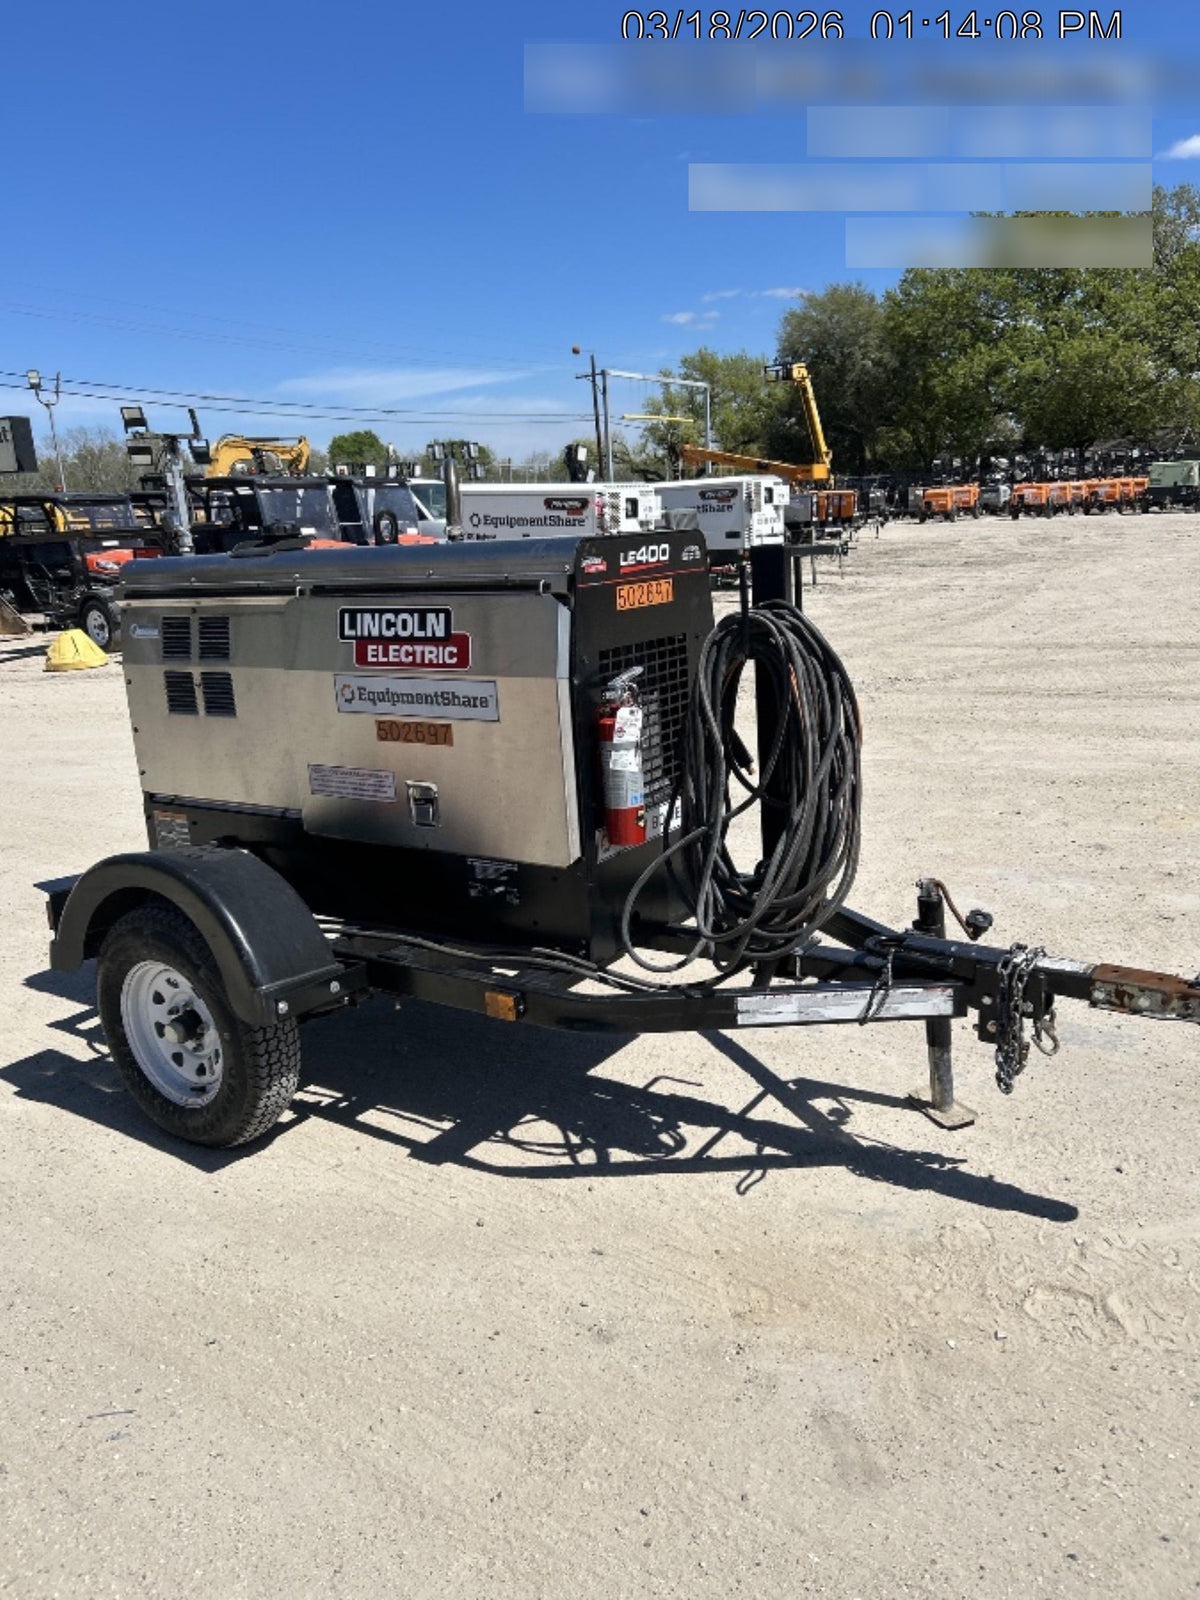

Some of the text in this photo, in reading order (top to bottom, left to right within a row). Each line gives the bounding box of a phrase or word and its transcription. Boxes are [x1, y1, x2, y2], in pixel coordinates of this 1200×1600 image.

[483, 514, 585, 528] EquipmentShare
[620, 543, 669, 566] LE400
[618, 581, 671, 609] 502697
[344, 612, 446, 638] LINCOLN
[367, 644, 458, 664] ELECTRIC
[357, 686, 490, 709] EquipmentShare
[376, 720, 451, 746] 502697
